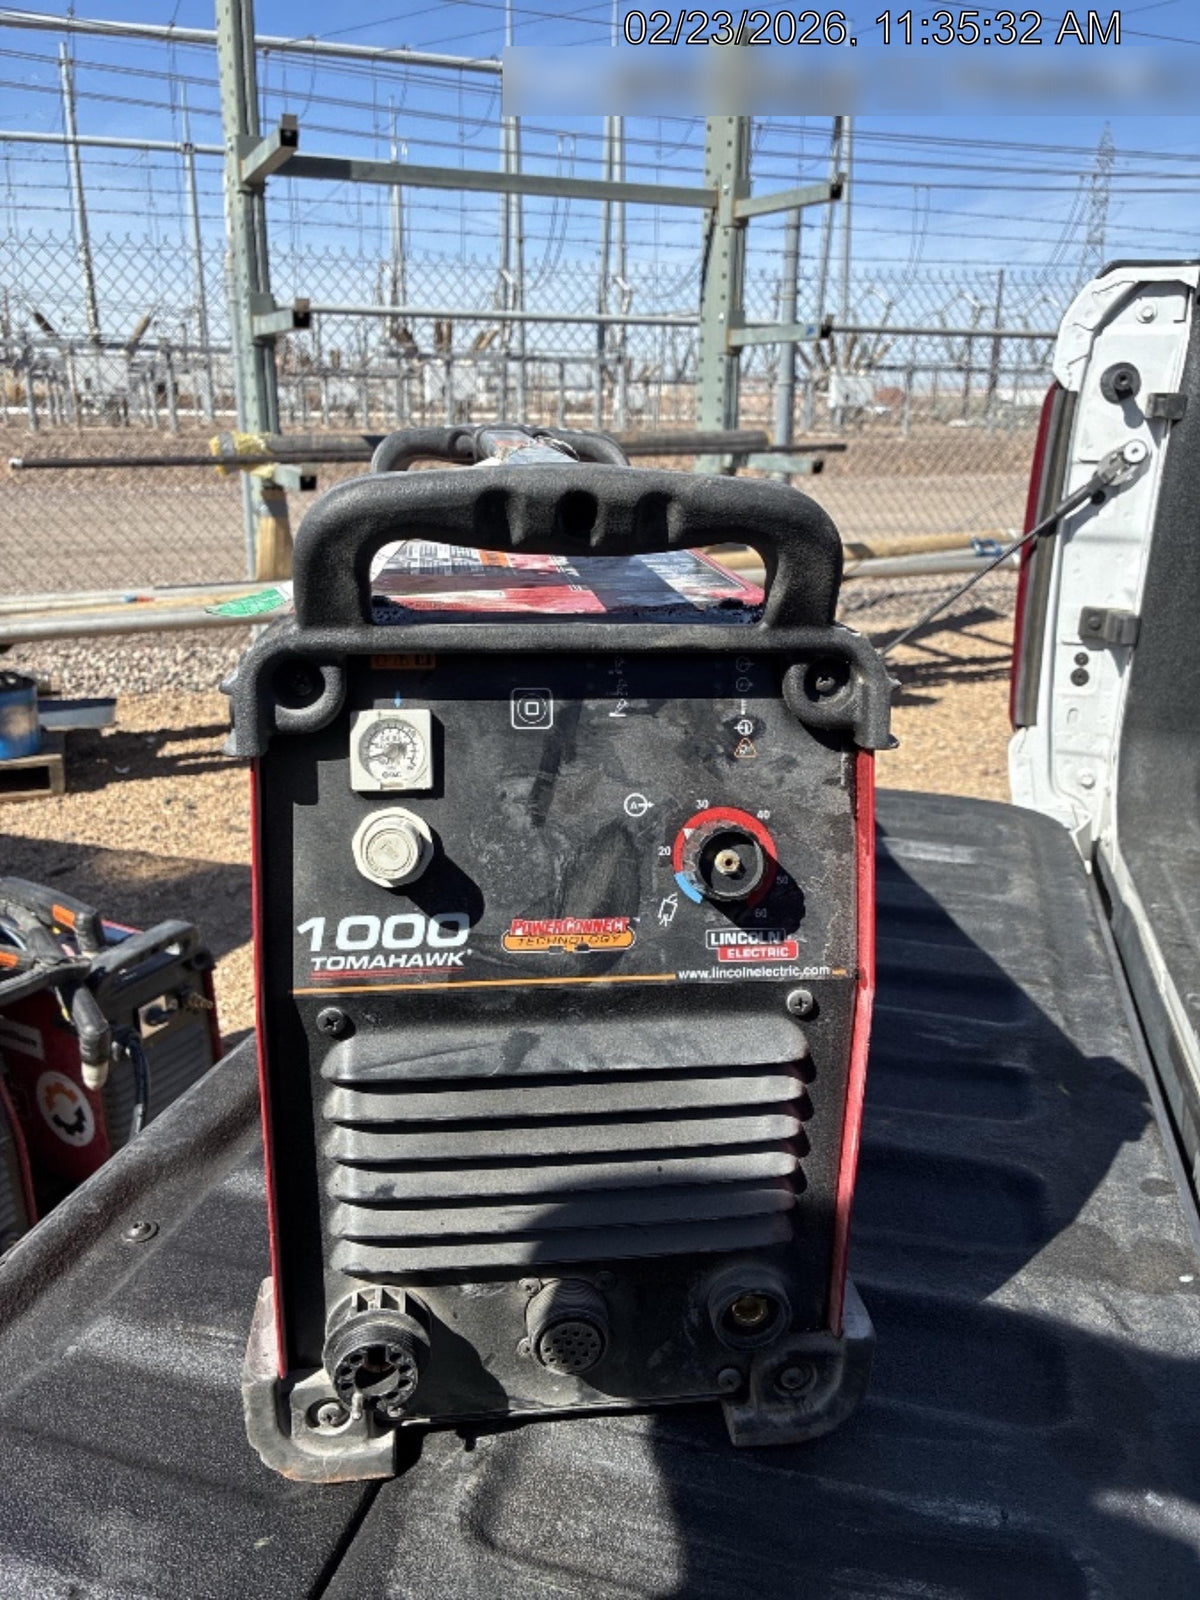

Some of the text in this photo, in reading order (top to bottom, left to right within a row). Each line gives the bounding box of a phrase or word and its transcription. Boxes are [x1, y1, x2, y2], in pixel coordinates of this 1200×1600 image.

[696, 799, 709, 810] 30
[757, 810, 771, 820] 40
[658, 845, 672, 856] 20
[296, 912, 470, 952] 1000
[710, 931, 781, 946] LINCOLN
[726, 947, 790, 960] ELECTRIC
[310, 952, 465, 972] TOMAHAWK
[678, 965, 831, 981] www.lincolnelectric.com
